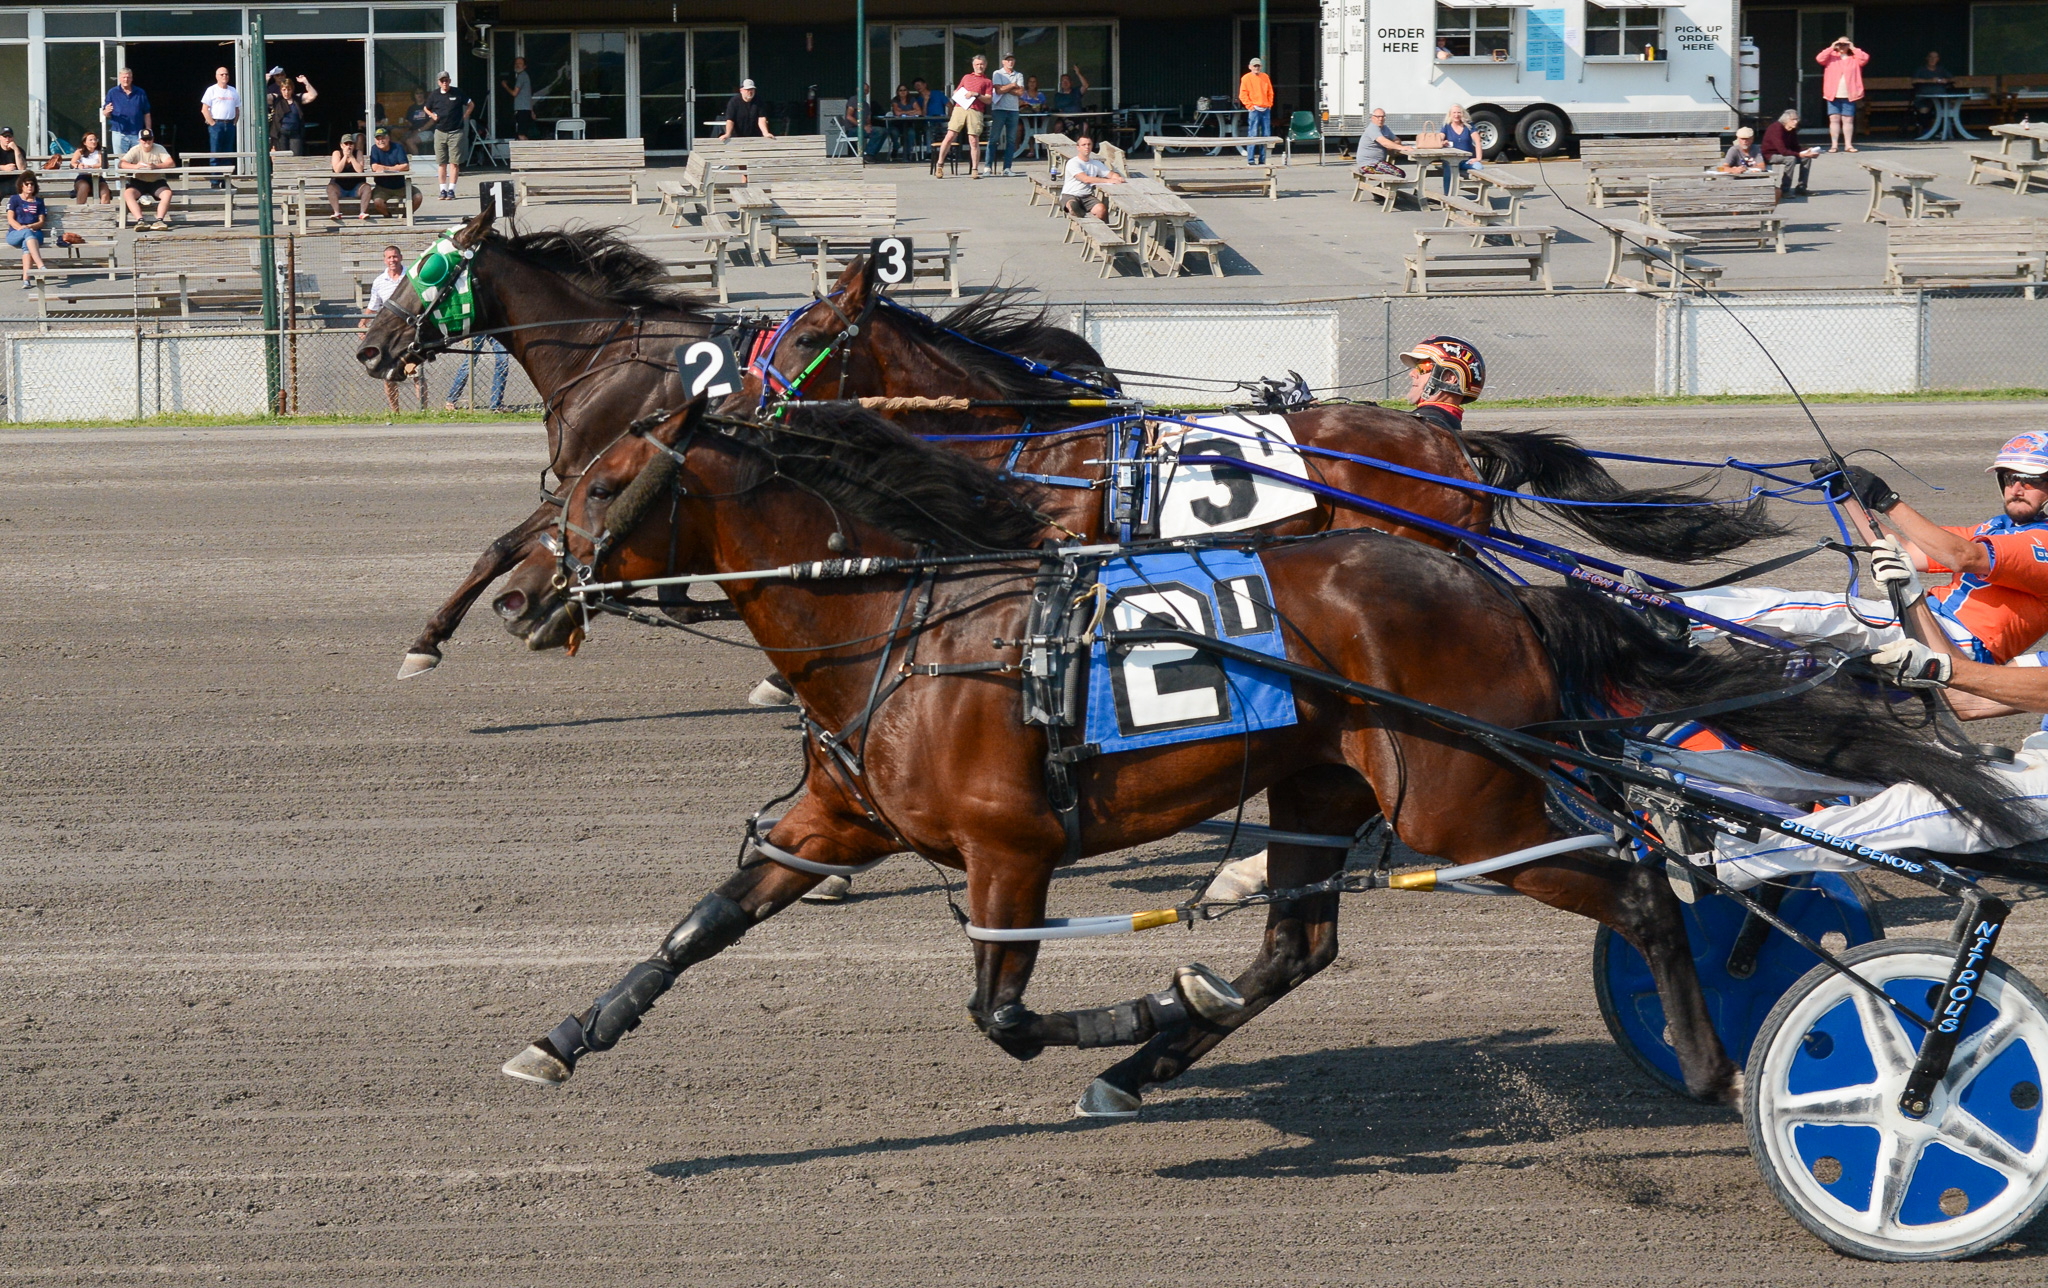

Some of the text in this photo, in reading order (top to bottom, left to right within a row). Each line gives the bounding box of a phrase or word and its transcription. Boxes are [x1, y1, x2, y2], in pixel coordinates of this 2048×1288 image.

[1377, 28, 1425, 38] ORDER
[1383, 43, 1419, 52] HERE
[490, 181, 504, 217] 1
[877, 238, 906, 283] 3
[684, 341, 733, 398] 2
[1181, 437, 1260, 527] 3
[1571, 567, 1614, 588] LEON
[1113, 590, 1219, 727] 2
[1780, 819, 1856, 851] STEEVEN
[1856, 846, 1923, 873] GENOIS
[1938, 920, 1998, 1033] NITROUS
